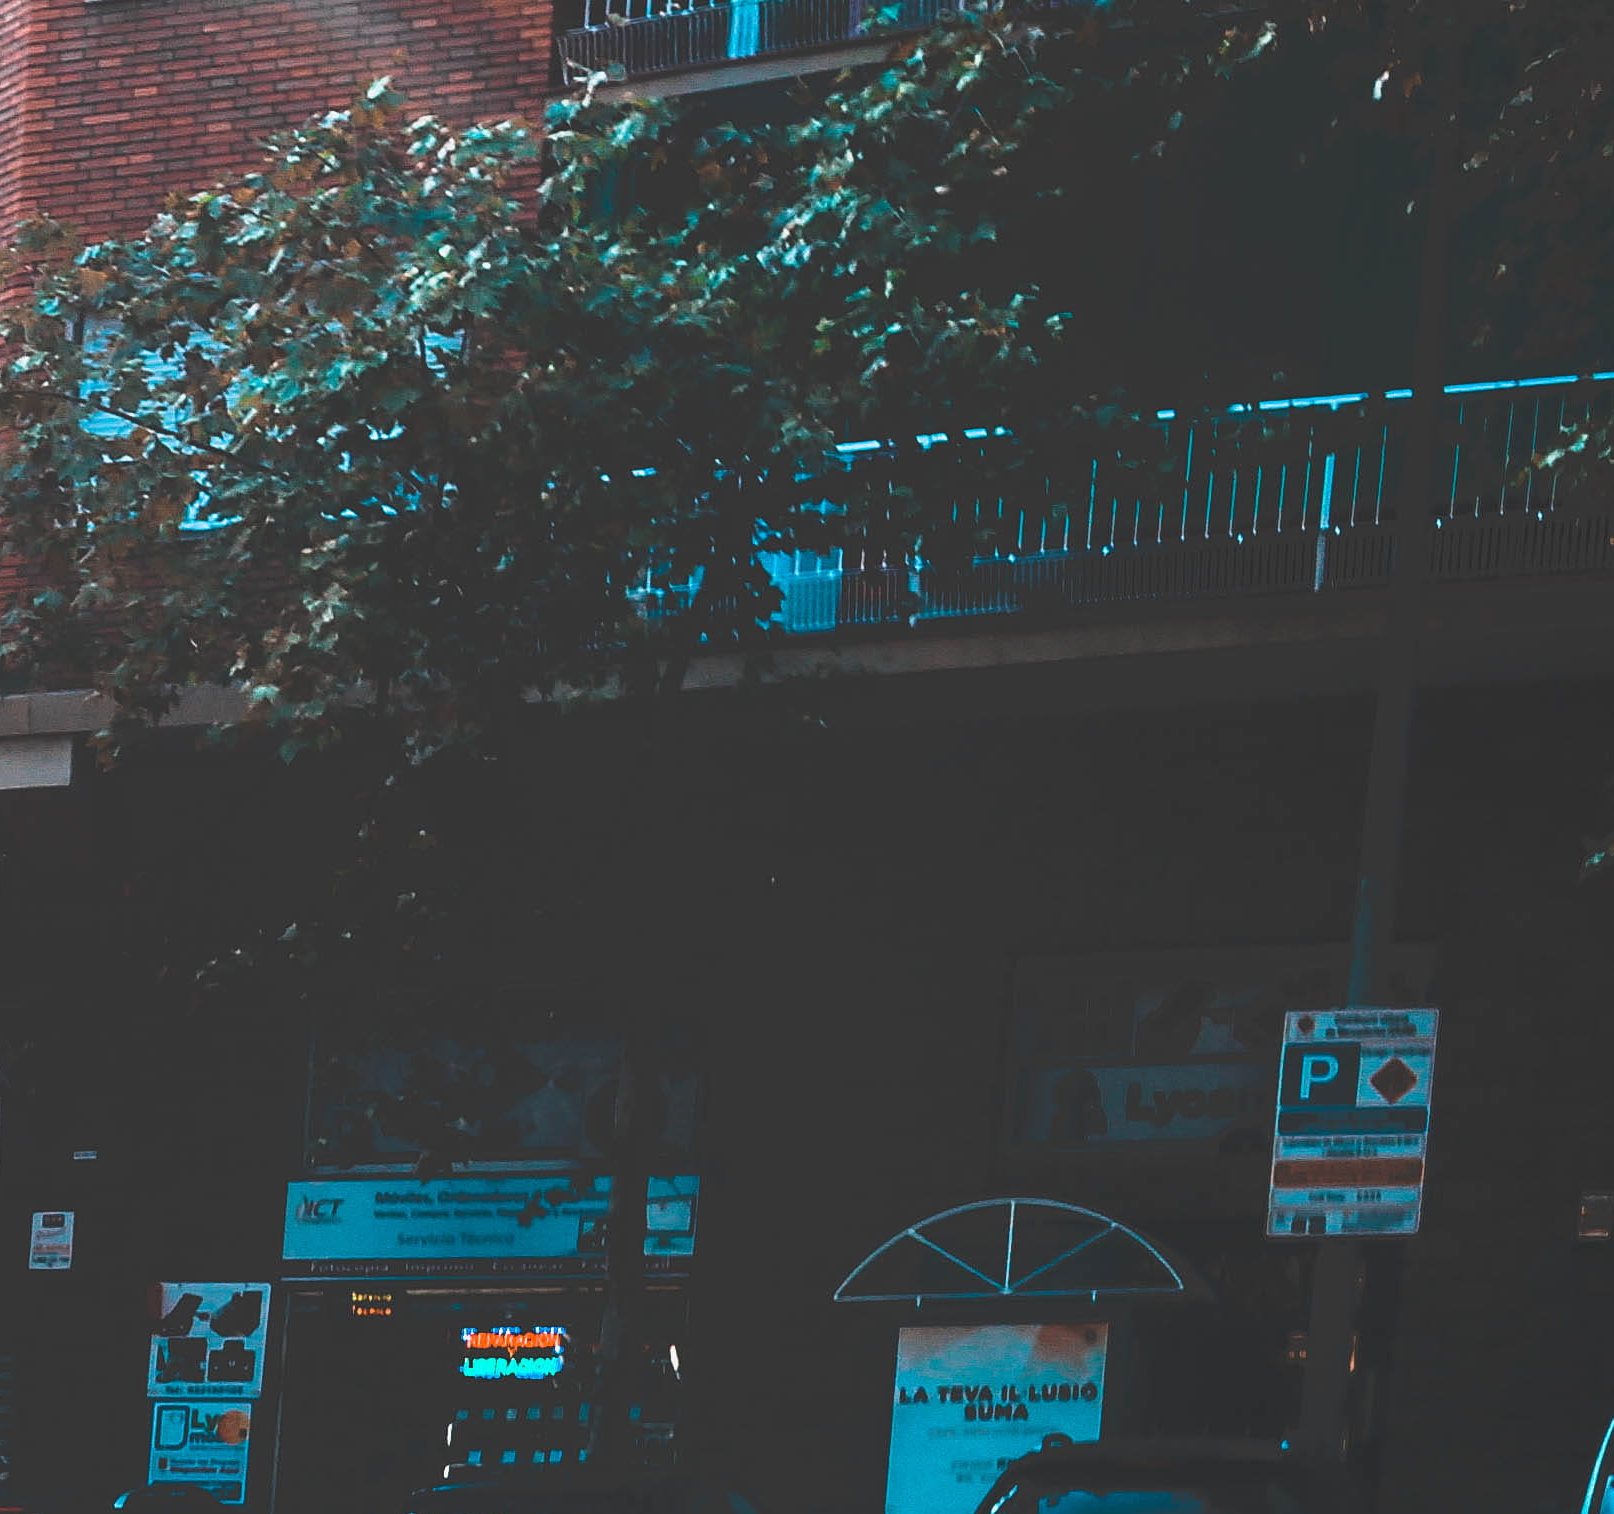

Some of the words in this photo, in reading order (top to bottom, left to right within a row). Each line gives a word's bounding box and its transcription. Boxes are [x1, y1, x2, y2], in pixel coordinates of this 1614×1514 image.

[1299, 1052, 1340, 1102] P
[899, 1387, 928, 1403] LA
[938, 1385, 993, 1402] TEVA
[964, 1403, 1028, 1421] SUMA
